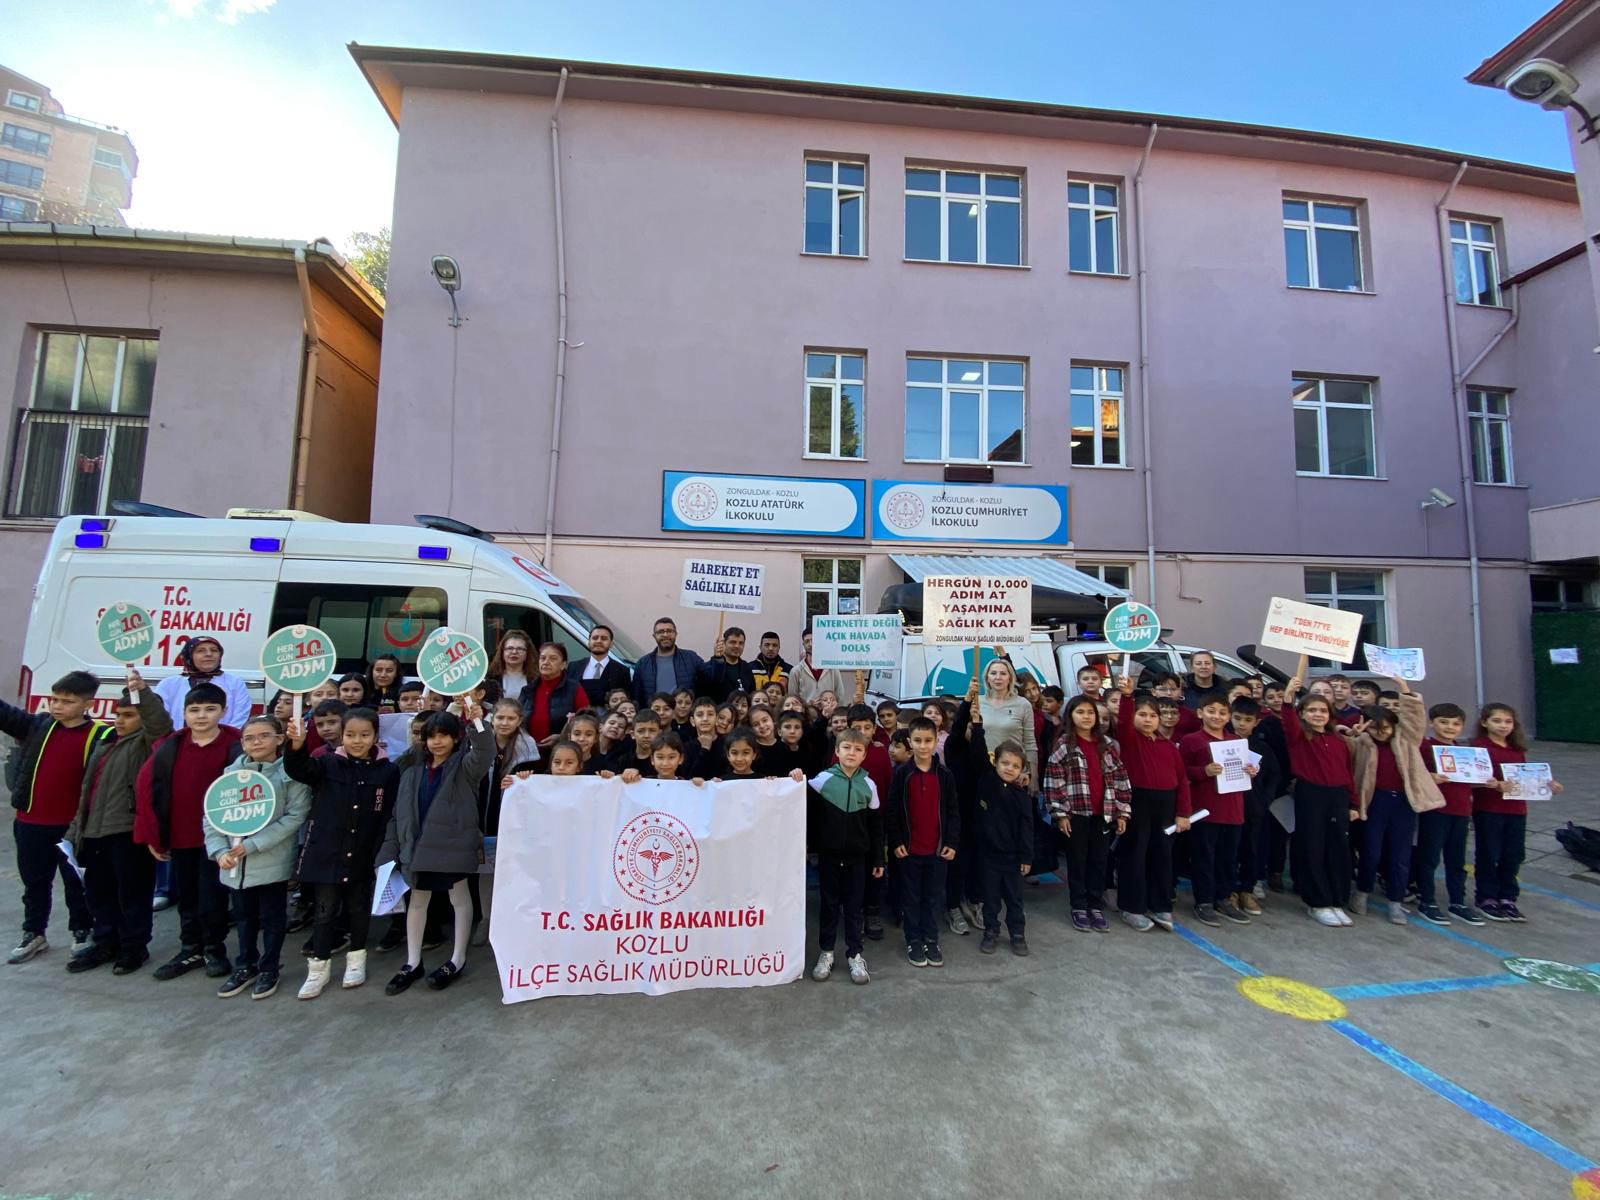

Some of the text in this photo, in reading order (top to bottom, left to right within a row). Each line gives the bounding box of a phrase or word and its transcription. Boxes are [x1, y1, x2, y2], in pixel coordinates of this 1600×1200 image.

[726, 488, 771, 496] ZONGULDAK
[776, 490, 799, 498] KOZLU
[726, 498, 804, 509] KOZLU ATATÜRK
[932, 496, 975, 504] ZONGULDAK
[726, 510, 774, 521] İLKOKULU
[932, 506, 1028, 516] KOZLU CUMHURİYET
[932, 517, 978, 527] İLKOKULU
[690, 562, 760, 579] HAREKET ET
[685, 578, 761, 596] SAĞLIKLI KAL
[927, 577, 1028, 588] HERGÜN 10.000
[163, 586, 191, 606] T.C.
[950, 591, 1007, 599] ADIM AT
[943, 604, 1013, 616] YAŞAMINA
[120, 612, 142, 632] 10
[160, 607, 251, 632] BAKANLIĞI
[816, 617, 900, 628] İNTERNETTE DEĞİL
[938, 617, 1016, 628] SAĞLIK KAT
[1129, 613, 1148, 627] 10
[1294, 617, 1312, 627] 7'DEN
[826, 632, 886, 642] AÇIK HAVADA
[1270, 625, 1283, 633] HEP
[1284, 627, 1313, 640] BİRLİKTE
[276, 643, 294, 654] HER
[295, 639, 321, 659] 10
[445, 641, 467, 664] 10
[841, 644, 871, 653] DOLAŞ
[276, 652, 294, 662] GÜN
[430, 652, 445, 666] HER
[434, 661, 448, 673] GÜN
[220, 788, 238, 798] HER
[239, 783, 263, 803] 10
[220, 797, 238, 806] GÜN
[540, 906, 765, 931] T.C. SAĞLIK BAKANLIĞI
[616, 934, 689, 955] KOZLU
[509, 951, 785, 990] İLÇE SAĞLIK MÜDÜRLÜĞÜ
